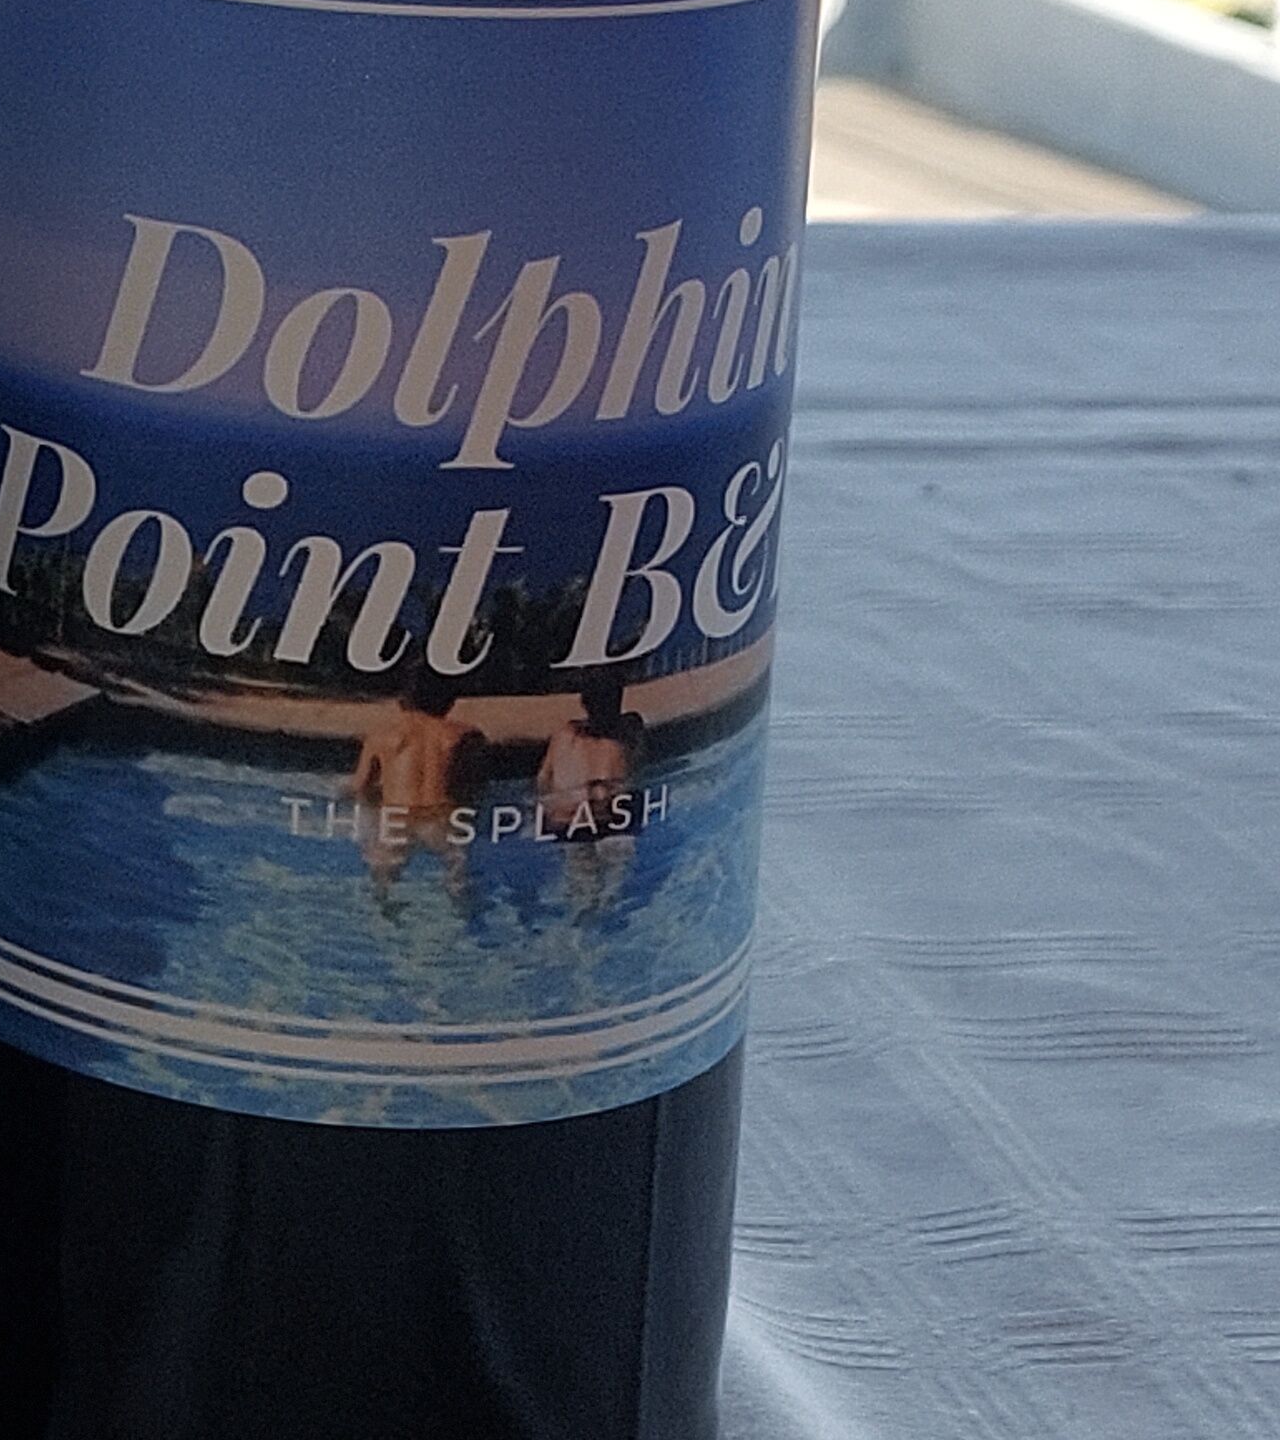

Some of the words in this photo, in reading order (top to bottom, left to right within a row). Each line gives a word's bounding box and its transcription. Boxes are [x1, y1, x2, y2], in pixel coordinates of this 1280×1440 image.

[80, 205, 798, 471] Dolphin
[550, 439, 786, 668] B&
[279, 795, 410, 844] THE
[446, 782, 673, 846] SPLASH
